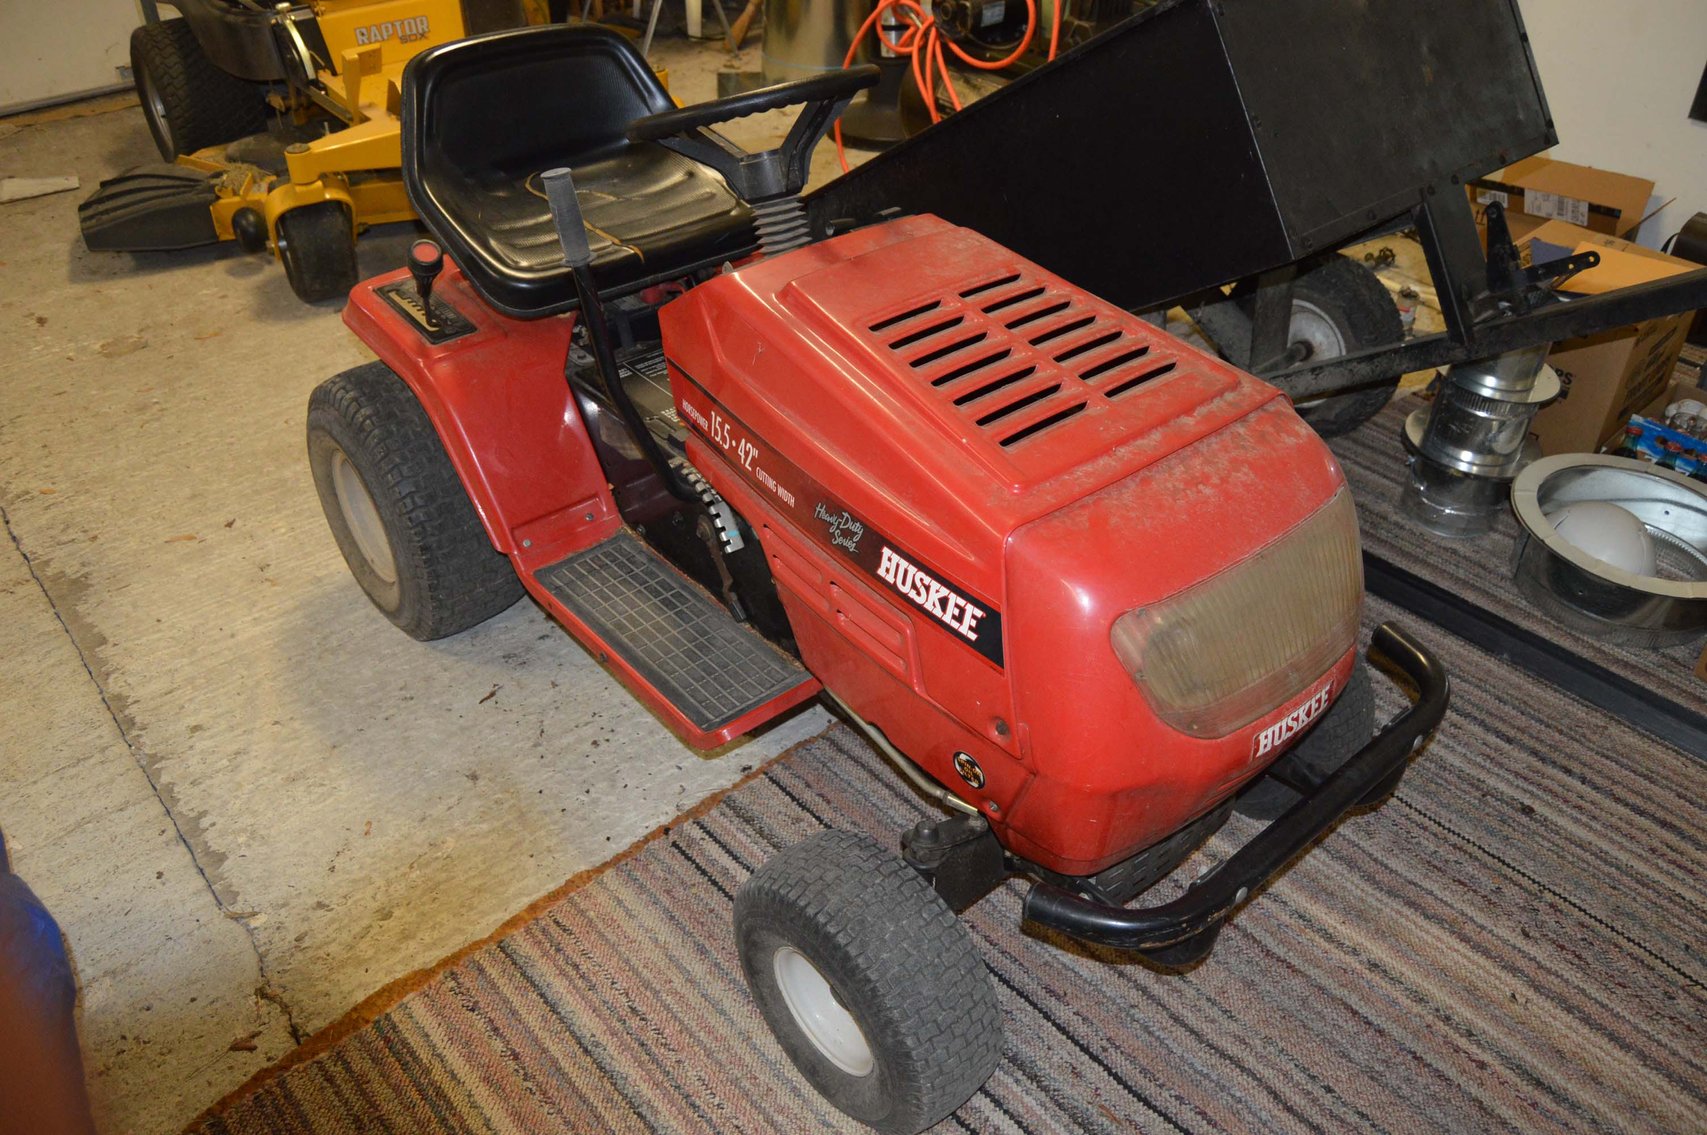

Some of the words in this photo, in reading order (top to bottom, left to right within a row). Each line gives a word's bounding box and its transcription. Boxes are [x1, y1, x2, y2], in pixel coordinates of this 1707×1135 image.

[354, 15, 429, 45] RAPTOR
[682, 399, 709, 432] HORSEPOWER
[711, 410, 731, 449] 15.5
[737, 438, 759, 472] 42"
[755, 467, 777, 493] CUTTING
[777, 484, 795, 508] WIDTH
[831, 528, 859, 553] Series
[876, 546, 984, 642] HUSKEE
[1256, 684, 1331, 758] HUSKEE
